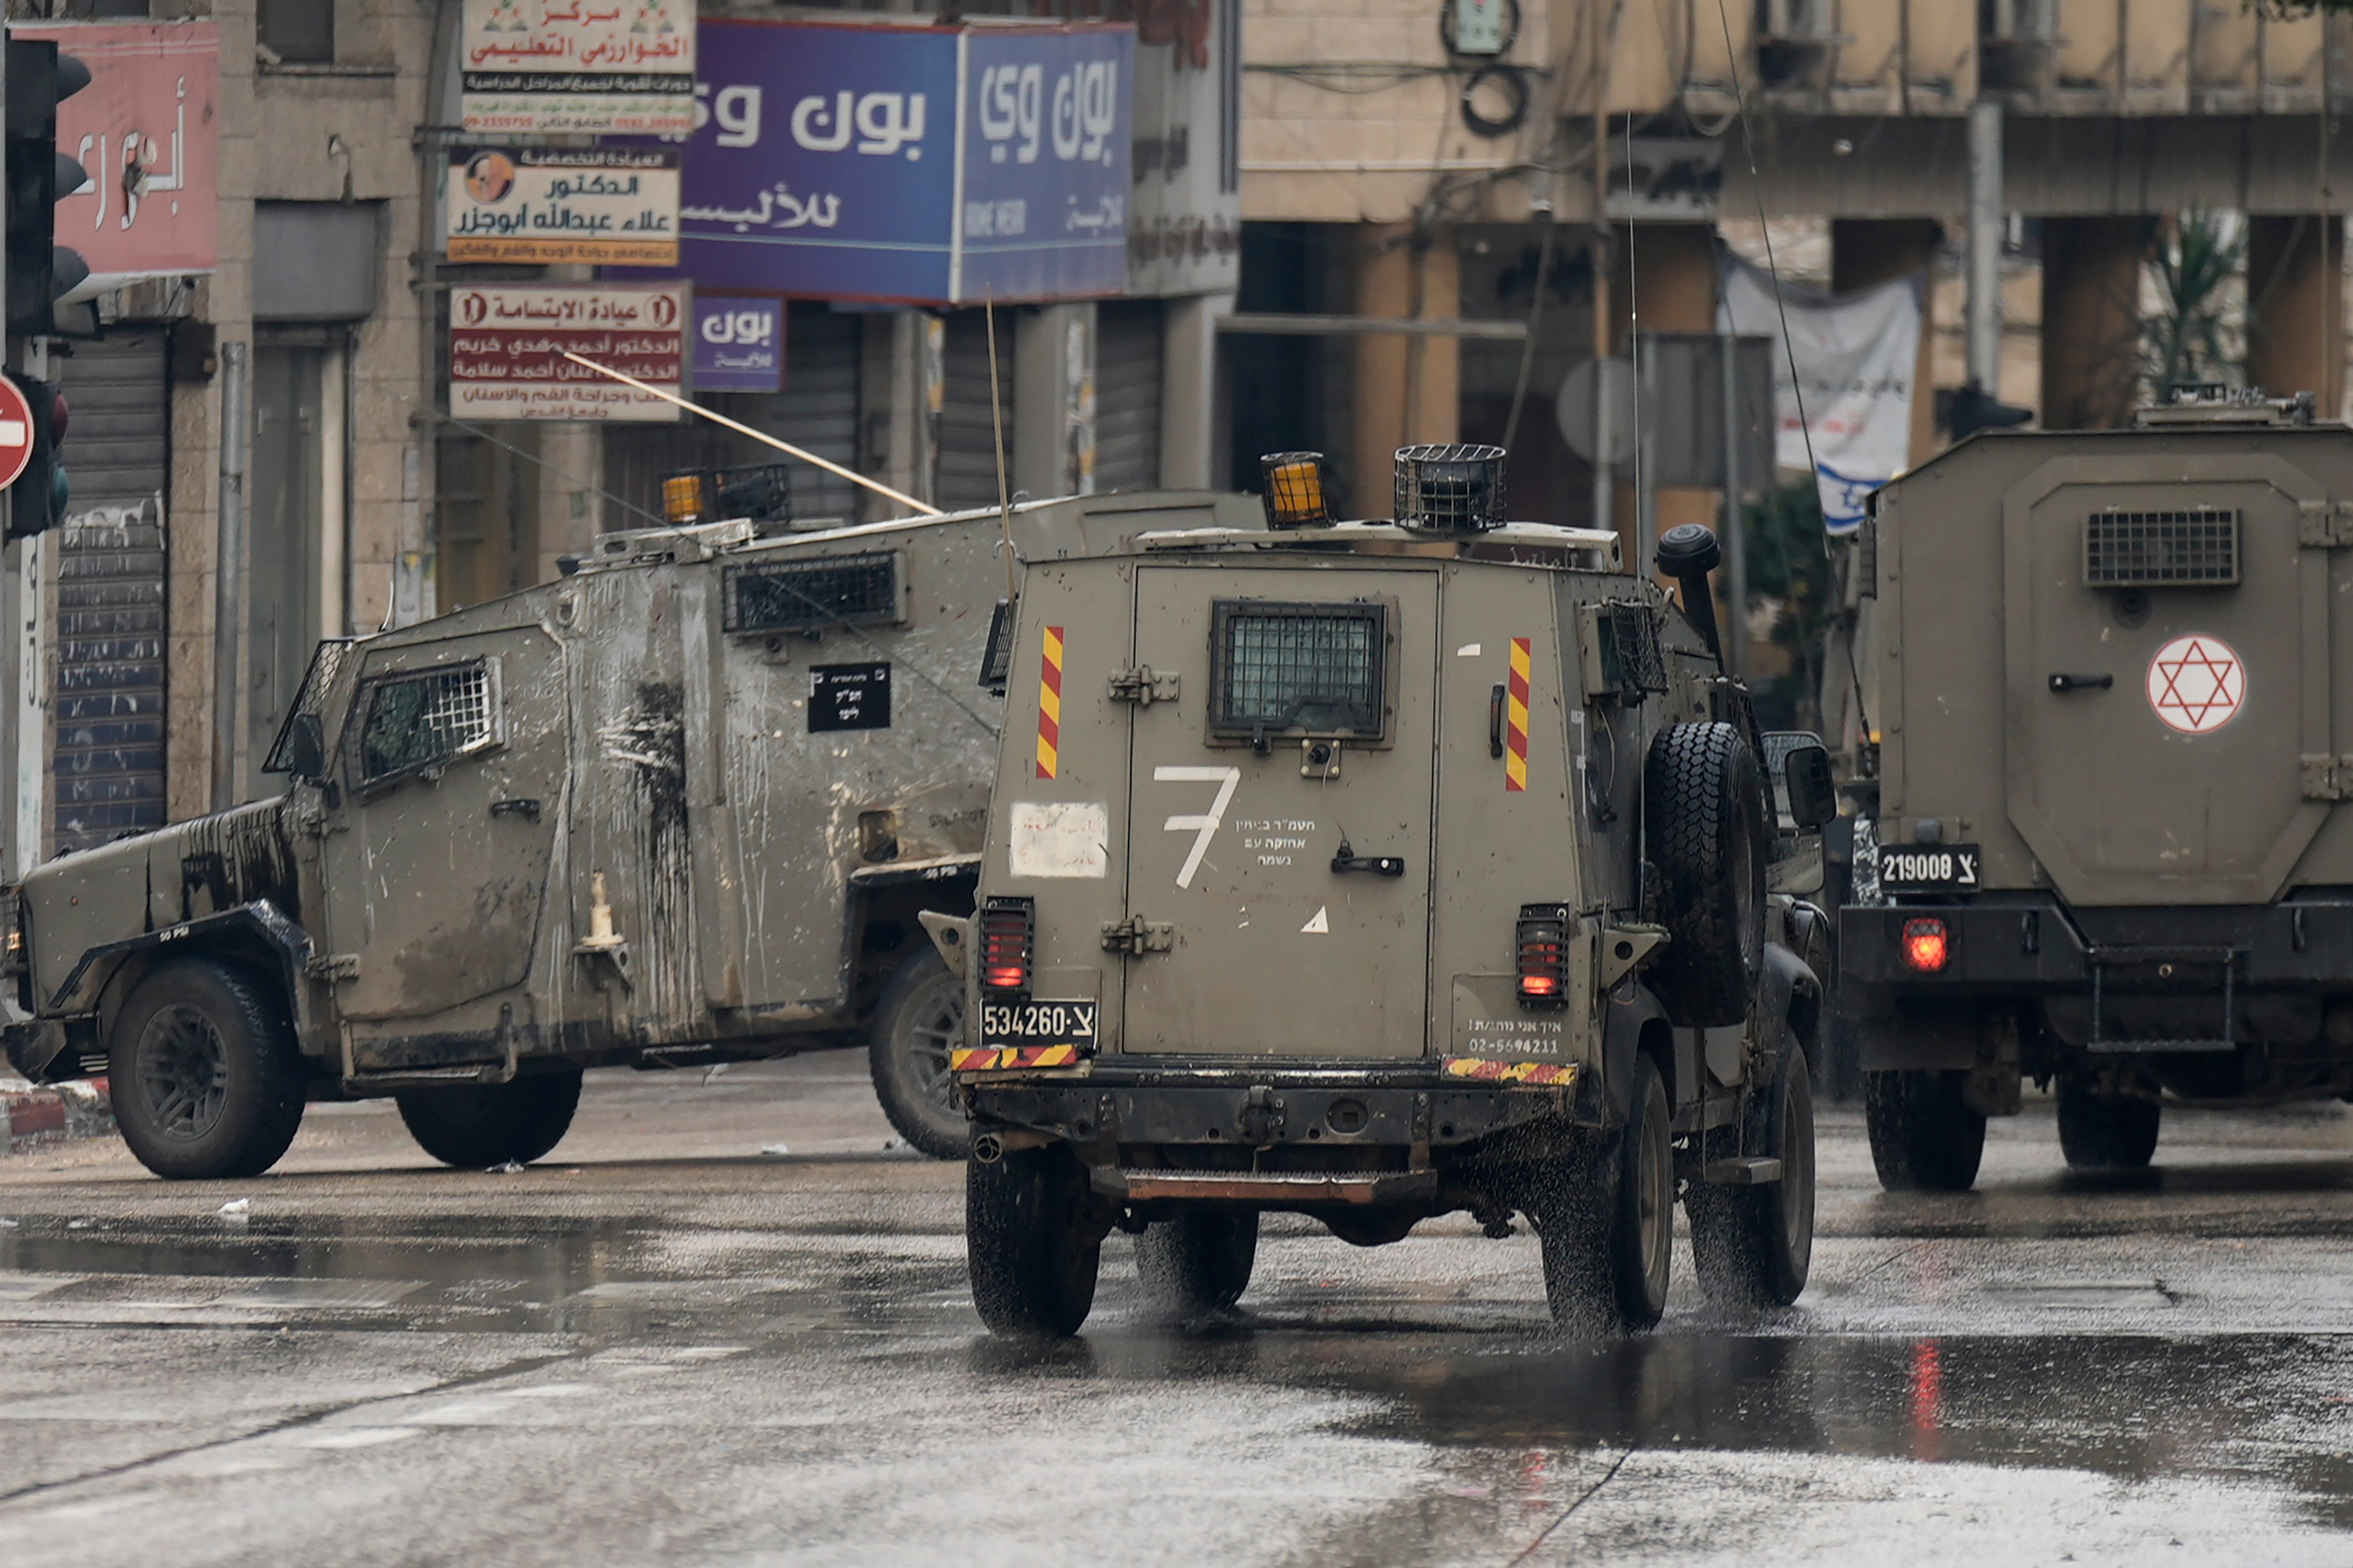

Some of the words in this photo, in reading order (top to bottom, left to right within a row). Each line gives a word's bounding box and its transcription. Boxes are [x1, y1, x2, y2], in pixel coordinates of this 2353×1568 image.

[542, 0, 620, 26] مركز
[470, 33, 573, 66] التعليمي
[580, 33, 688, 67] الخوارزمي
[791, 90, 927, 162] بون
[979, 63, 1043, 165] وي
[1052, 61, 1118, 167] بون
[72, 132, 106, 231] رع
[543, 175, 638, 200] الدكتور
[533, 203, 612, 235] عبدالله
[680, 181, 842, 233] للألبس
[621, 210, 670, 231] علاء
[494, 296, 585, 328] الابتسامة
[589, 297, 638, 327] عيادة
[701, 311, 772, 347] بون
[568, 333, 612, 354] أحمد
[614, 336, 679, 356] الدكتور
[453, 357, 507, 379] سلامة
[510, 358, 555, 379] أحمد
[532, 388, 568, 403] الفم
[573, 388, 630, 403] وجراحة
[1153, 766, 1241, 890] 7
[1243, 837, 1262, 850] עם
[1265, 838, 1306, 851] אחזקה
[1883, 852, 1953, 882] 219008
[1518, 1021, 1537, 1033] אני
[1539, 1021, 1562, 1034] איך
[1468, 1037, 1559, 1054] 02-5694211
